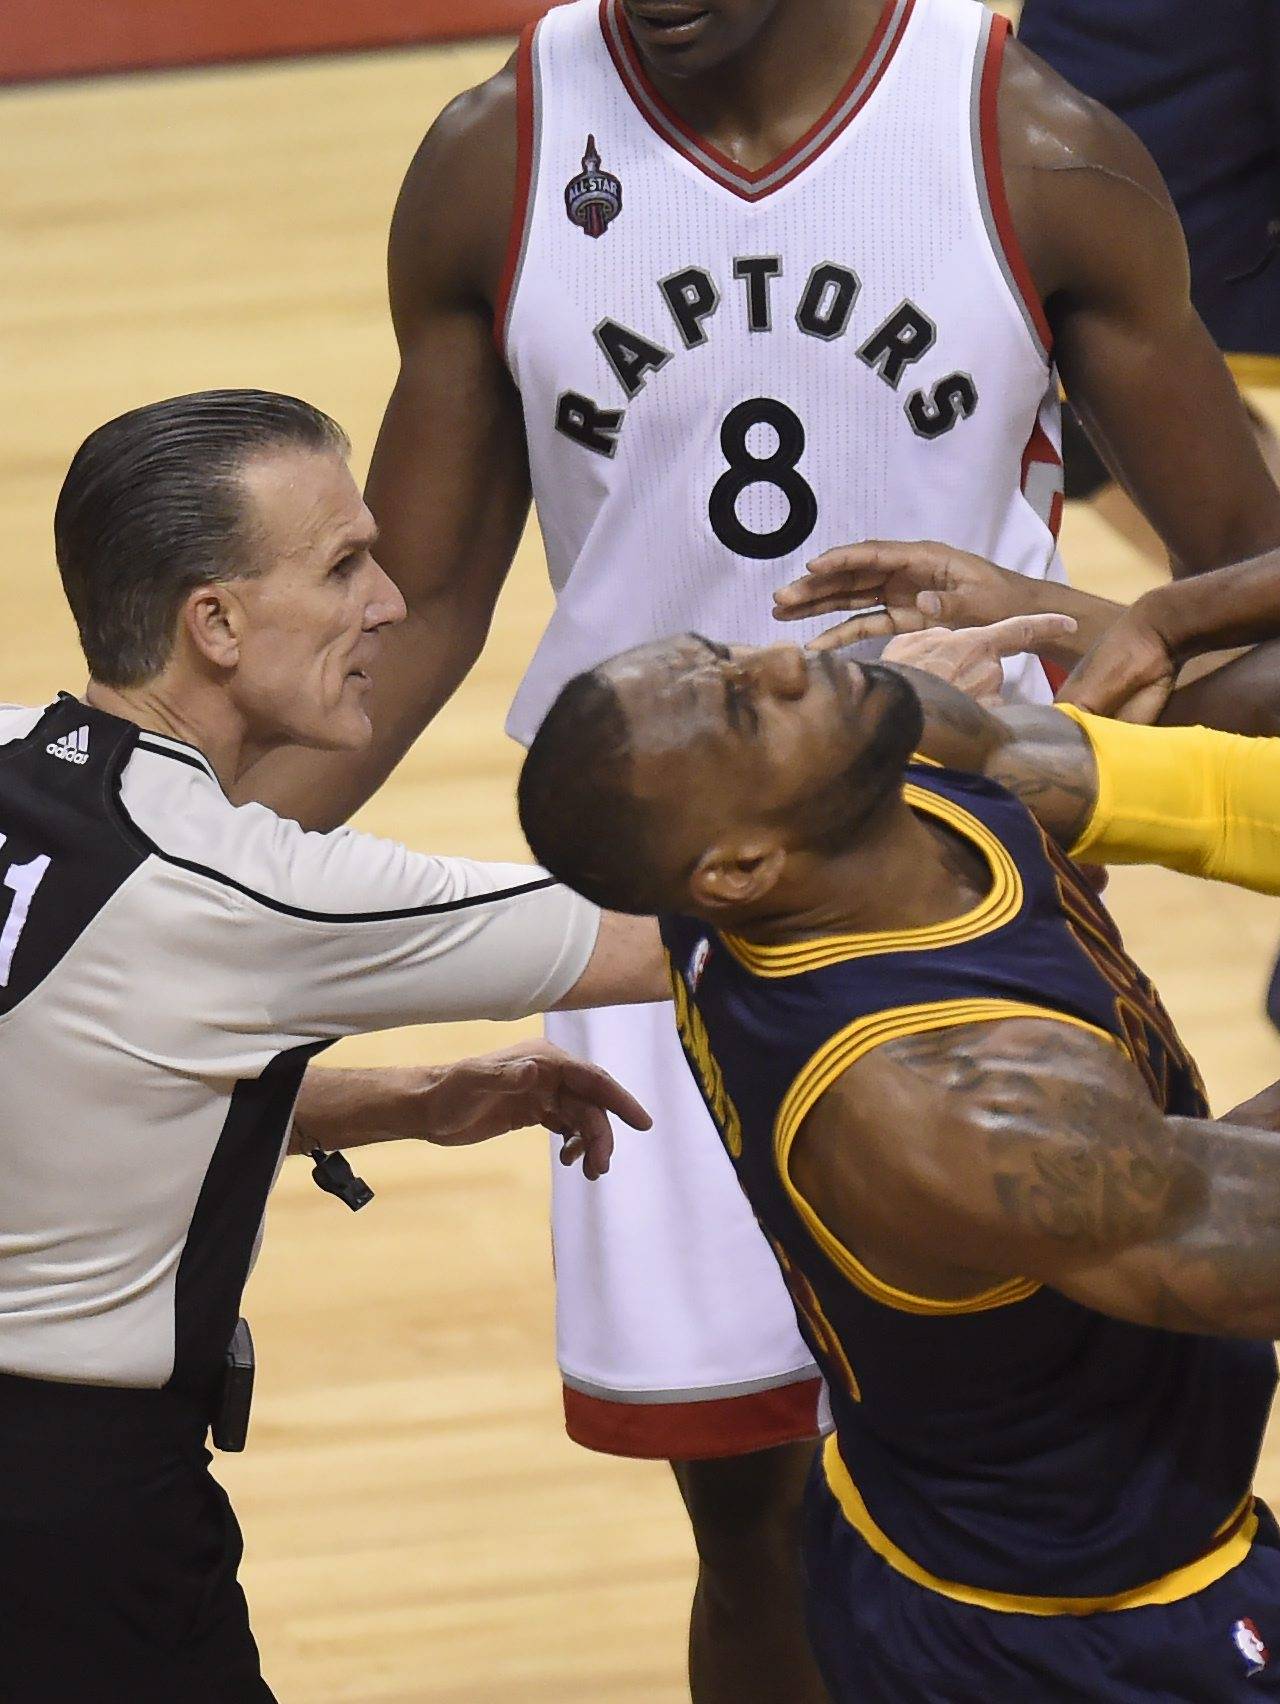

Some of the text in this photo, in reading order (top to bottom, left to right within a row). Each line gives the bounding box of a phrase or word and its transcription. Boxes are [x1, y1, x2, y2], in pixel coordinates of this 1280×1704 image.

[554, 254, 979, 459] RAPTORS
[708, 397, 818, 560] 8
[45, 743, 90, 765] adidas
[0, 832, 52, 988] 1
